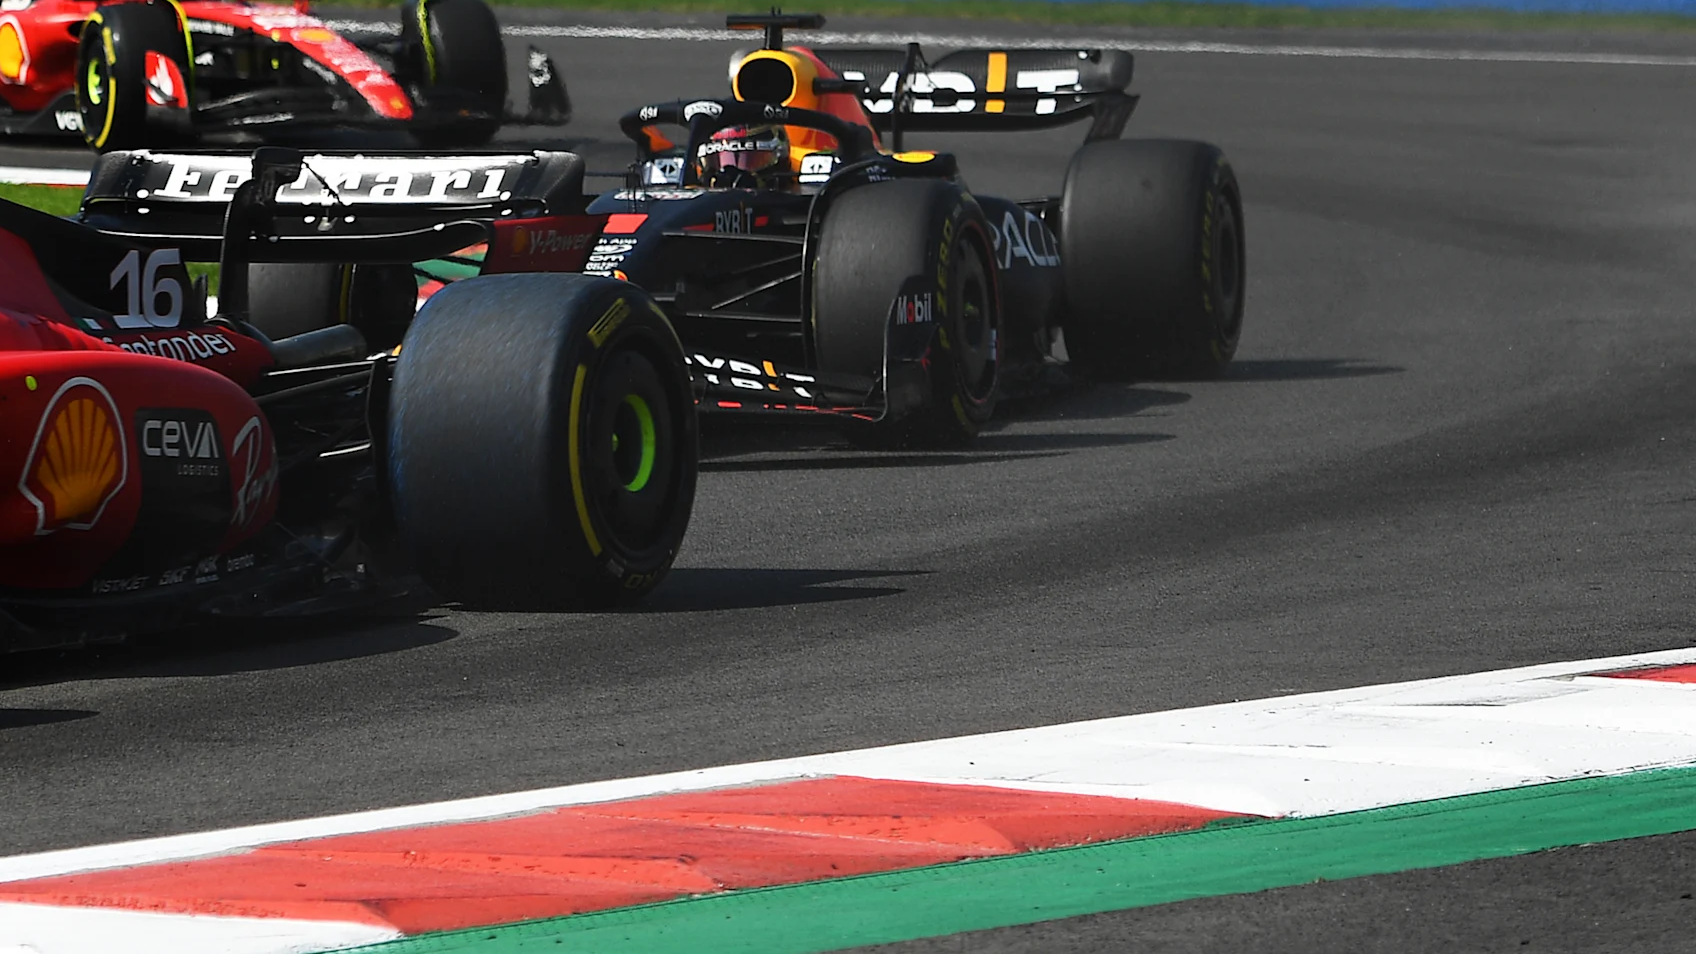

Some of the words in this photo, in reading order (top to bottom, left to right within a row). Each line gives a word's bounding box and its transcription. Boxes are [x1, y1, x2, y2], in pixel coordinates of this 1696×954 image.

[153, 162, 509, 203] Ferari
[529, 229, 593, 255] V-Power
[109, 247, 184, 330] 16
[896, 292, 933, 325] Mobil
